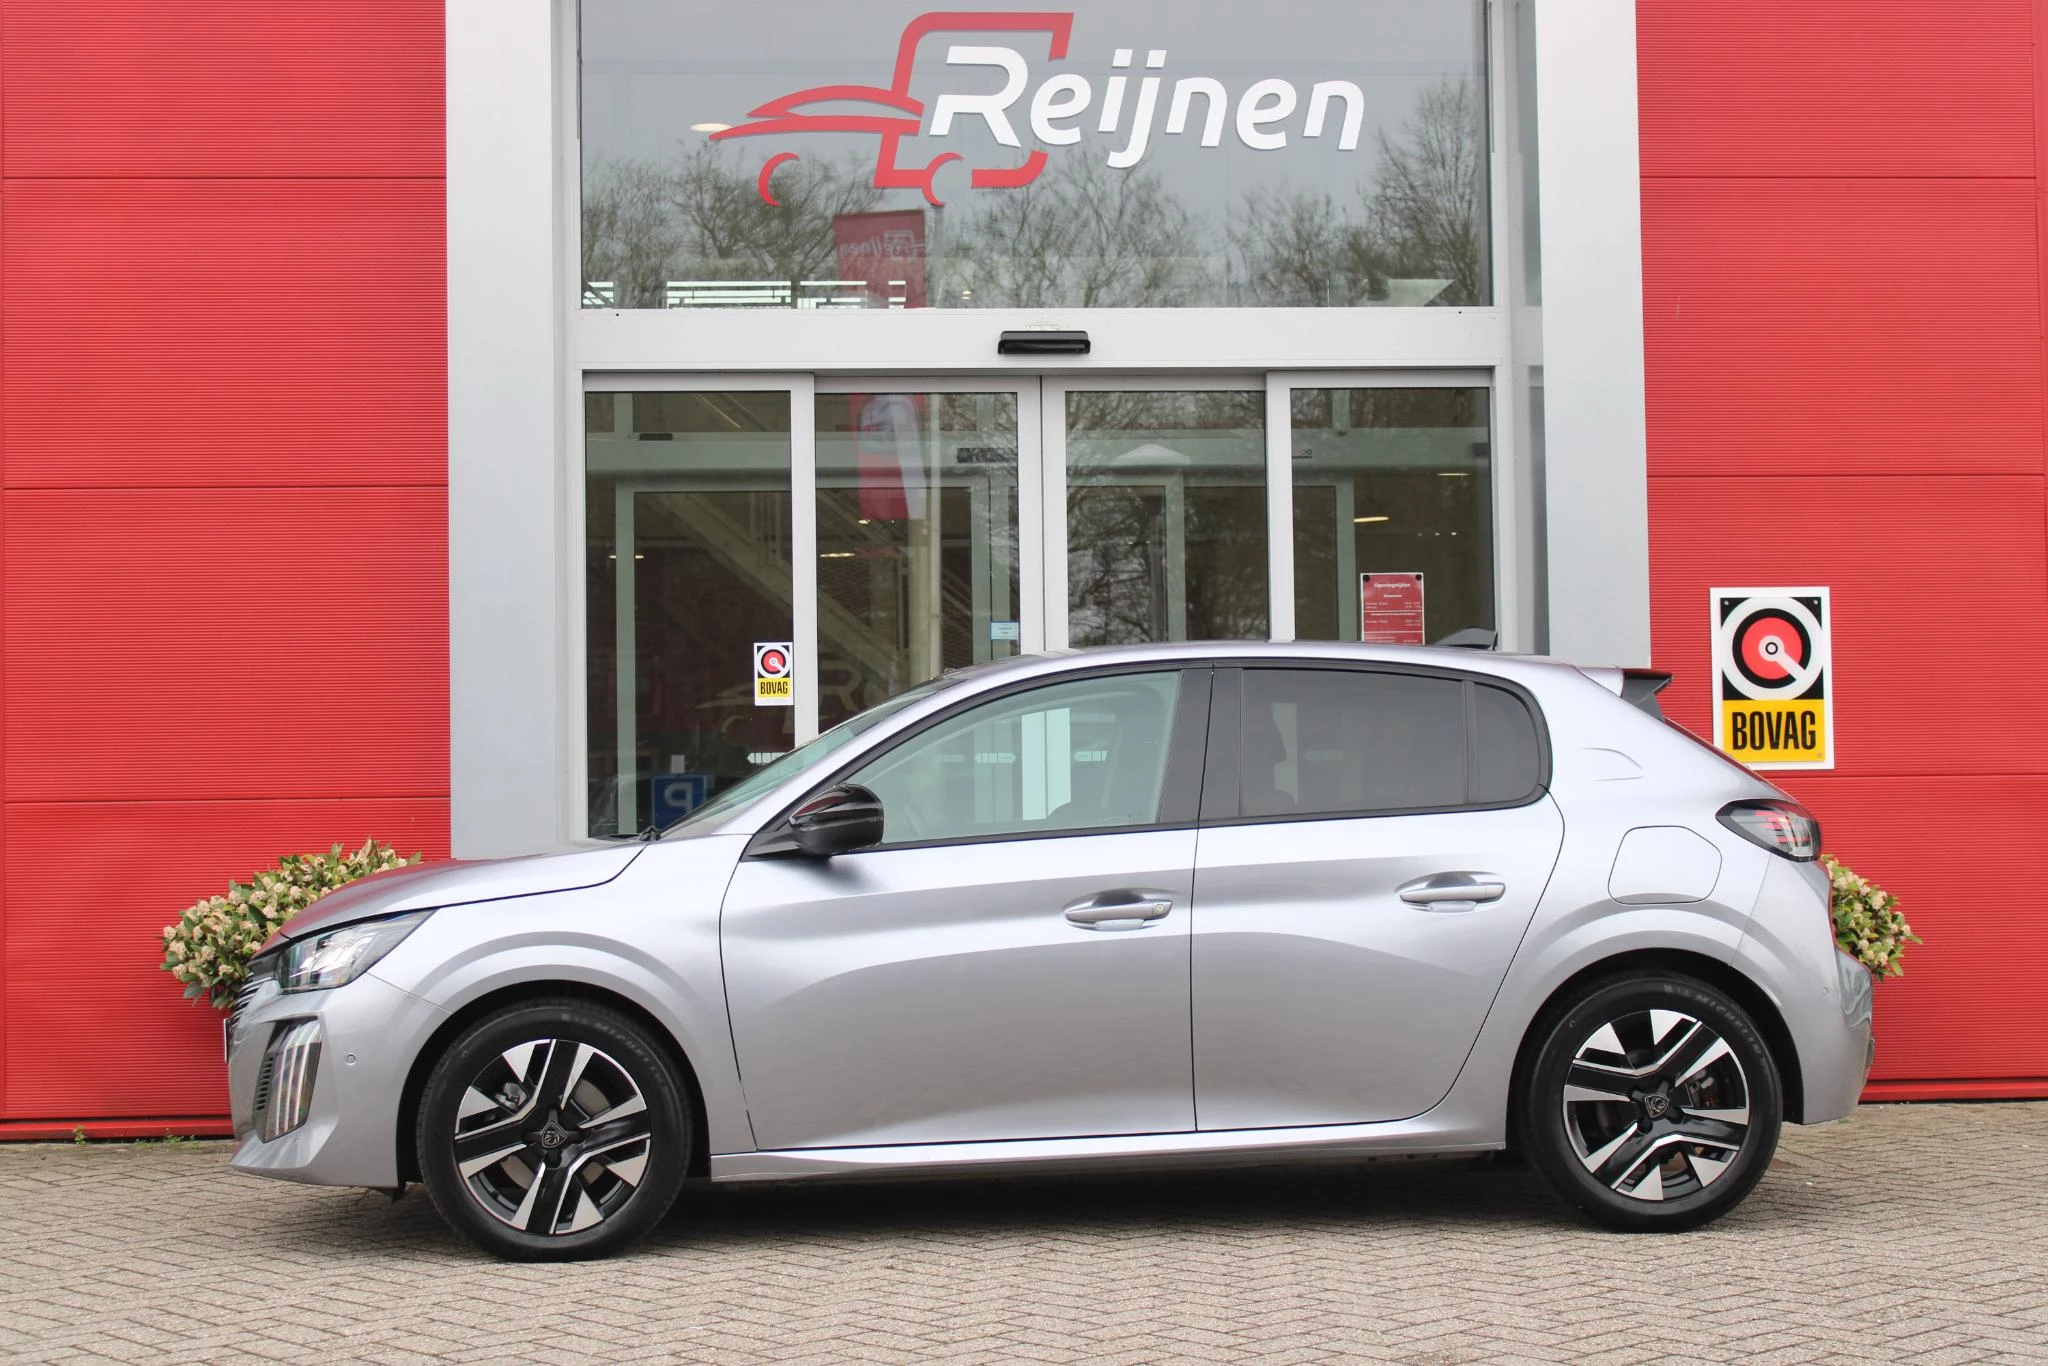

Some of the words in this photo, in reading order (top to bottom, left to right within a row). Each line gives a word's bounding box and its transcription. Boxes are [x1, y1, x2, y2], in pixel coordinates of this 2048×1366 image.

[929, 46, 1365, 169] Reijnen
[760, 681, 788, 694] BOVAG
[1732, 711, 1816, 750] BOVAG
